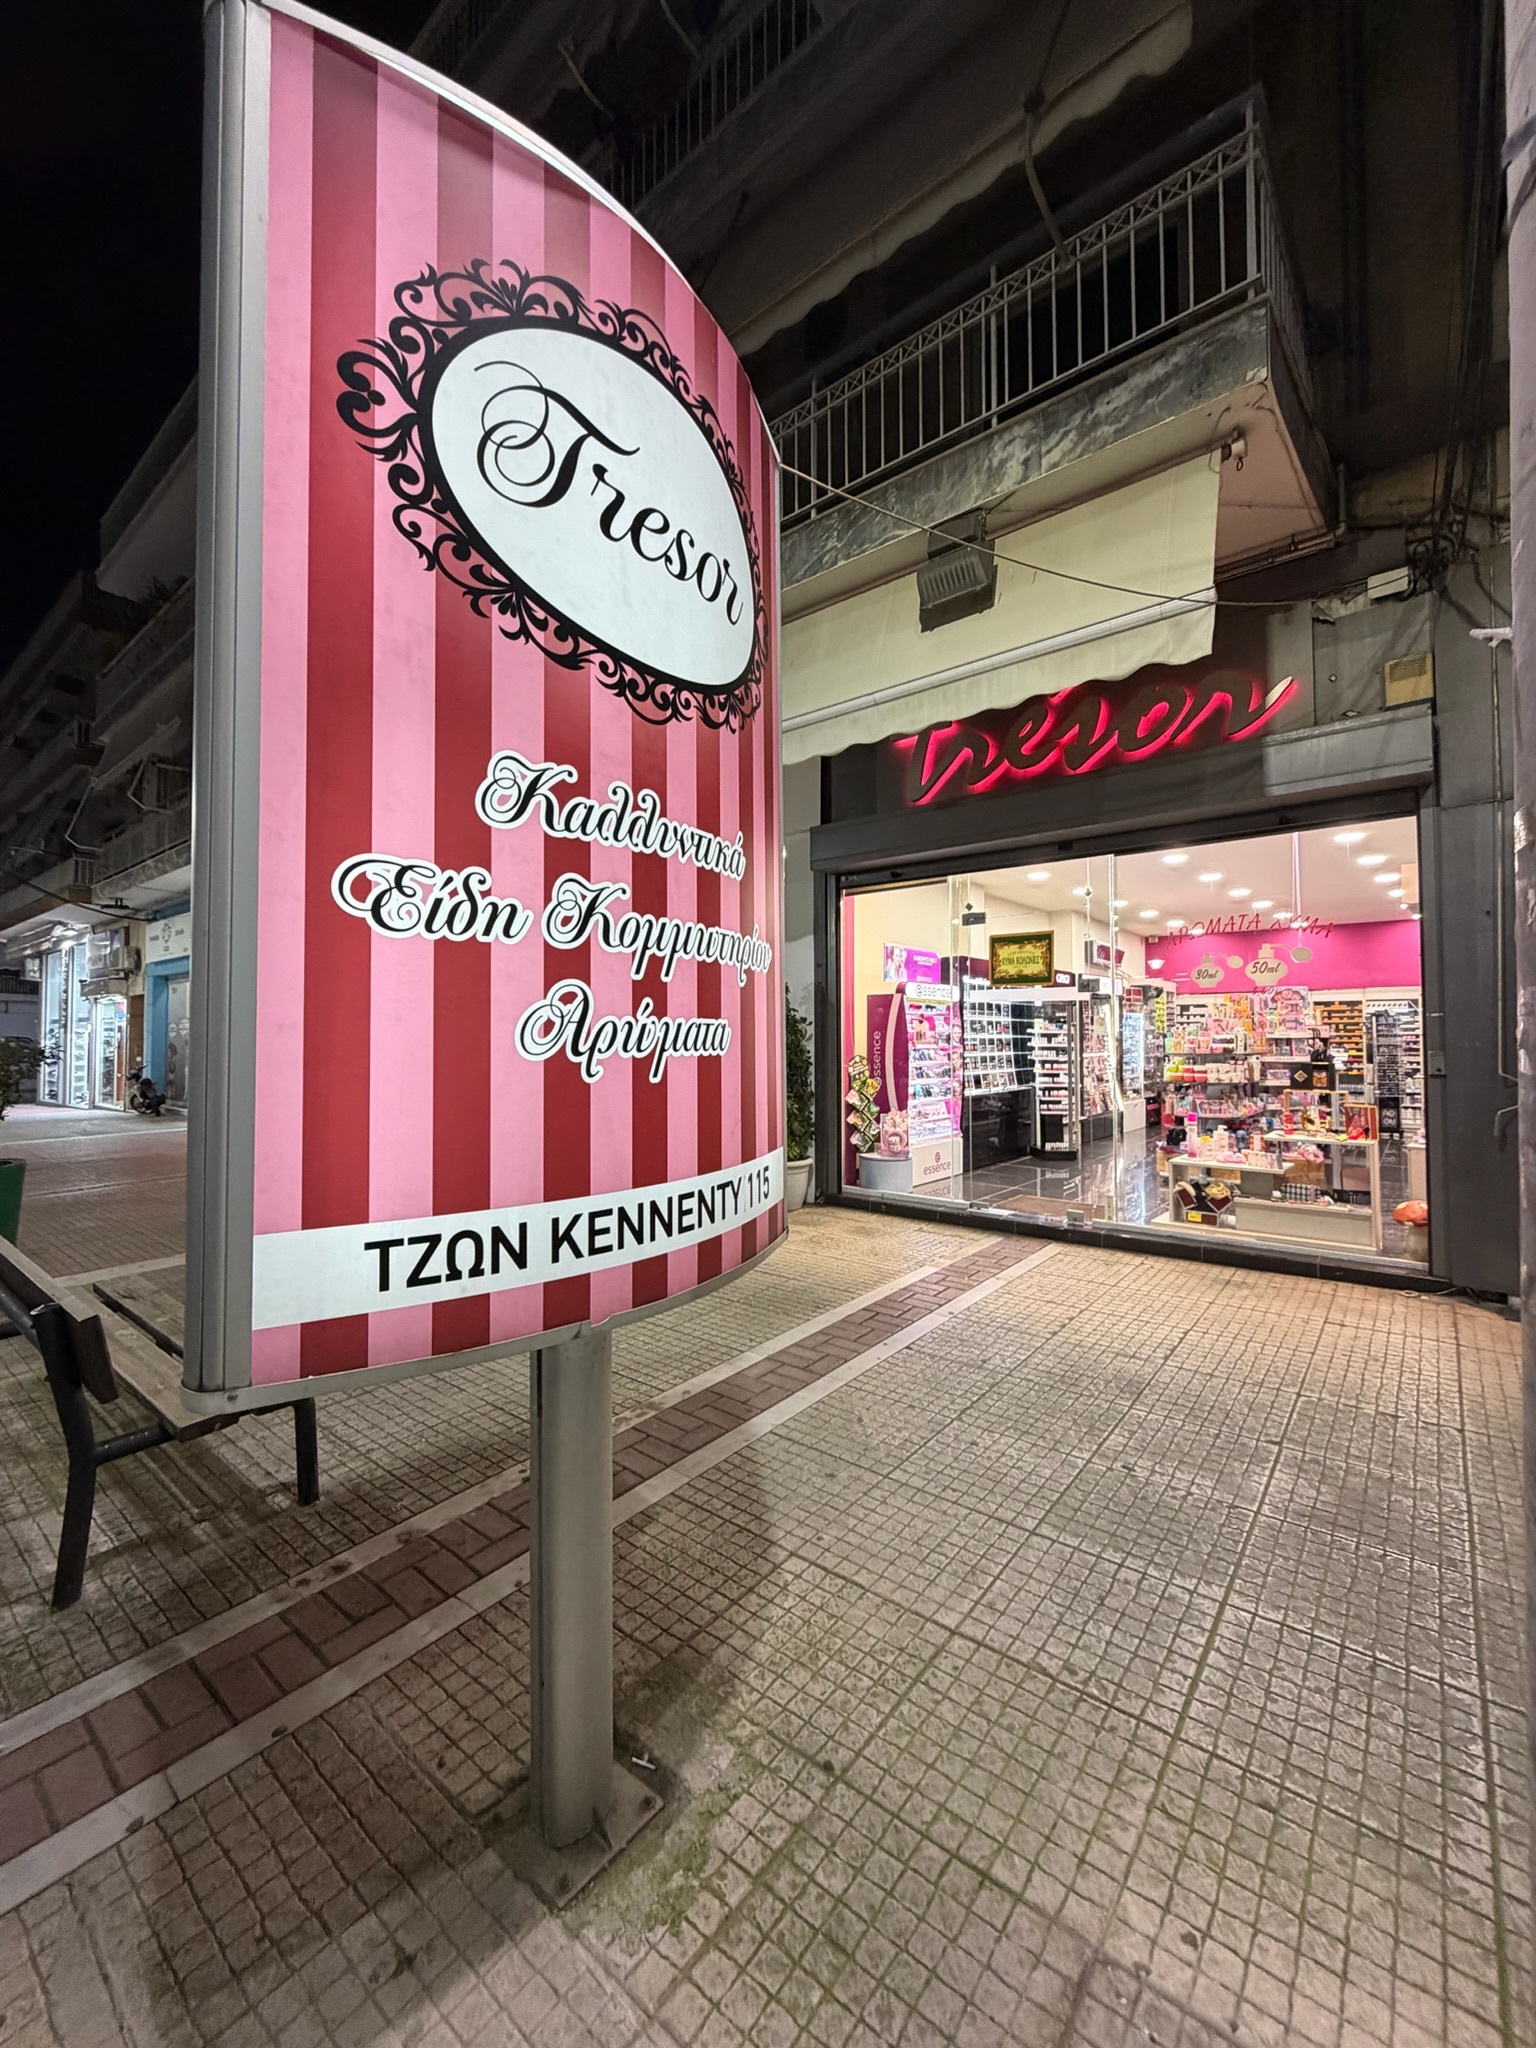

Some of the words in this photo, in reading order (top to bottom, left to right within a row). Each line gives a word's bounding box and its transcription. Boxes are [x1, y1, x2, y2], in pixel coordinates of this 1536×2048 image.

[474, 360, 744, 627] Tresor
[480, 754, 745, 877] Καλλυντικά
[338, 858, 528, 938] Είδη
[916, 984, 952, 998] essence
[1195, 968, 1219, 980] 30ml
[1250, 961, 1281, 974] 50ml
[520, 983, 729, 1080] Αρώματα
[923, 1161, 951, 1176] essence
[364, 1221, 528, 1293] ΤΖΩΝ
[551, 1176, 743, 1264] ΚΕΝΝΕΝΤΥ
[747, 1165, 770, 1208] 115
